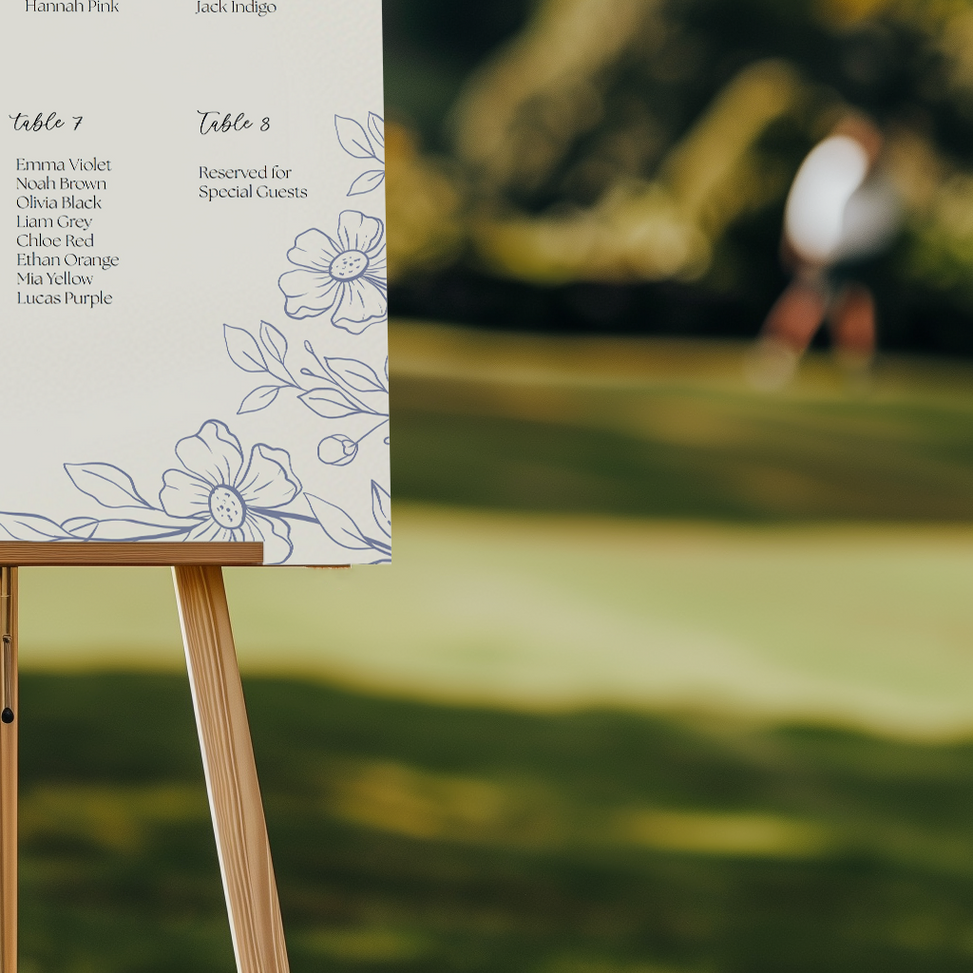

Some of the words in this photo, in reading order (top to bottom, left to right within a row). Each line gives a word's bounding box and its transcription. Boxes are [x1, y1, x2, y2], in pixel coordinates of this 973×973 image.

[195, 0, 227, 14] Jack
[232, 0, 277, 17] Indigo
[8, 112, 65, 132] table
[72, 116, 83, 131] 7
[260, 117, 270, 132] 8
[16, 158, 65, 171] Emma
[69, 157, 112, 171] Violet
[199, 165, 267, 179] Reserved
[272, 165, 292, 180] for
[16, 176, 56, 190] Noah
[60, 177, 106, 190] Brown
[199, 184, 252, 202] Special
[256, 185, 307, 199] Guests
[17, 195, 57, 209] Olivia
[62, 195, 102, 209] Black
[17, 215, 53, 228] Liam
[57, 215, 93, 231] Grey
[17, 233, 61, 247] Chloe
[66, 233, 94, 247] Red
[17, 251, 60, 266] Ethan
[64, 253, 119, 270] Orange
[17, 272, 43, 285] Mia
[46, 271, 93, 285] Yellow
[17, 291, 61, 304] Lucas
[65, 290, 113, 309] Purple
